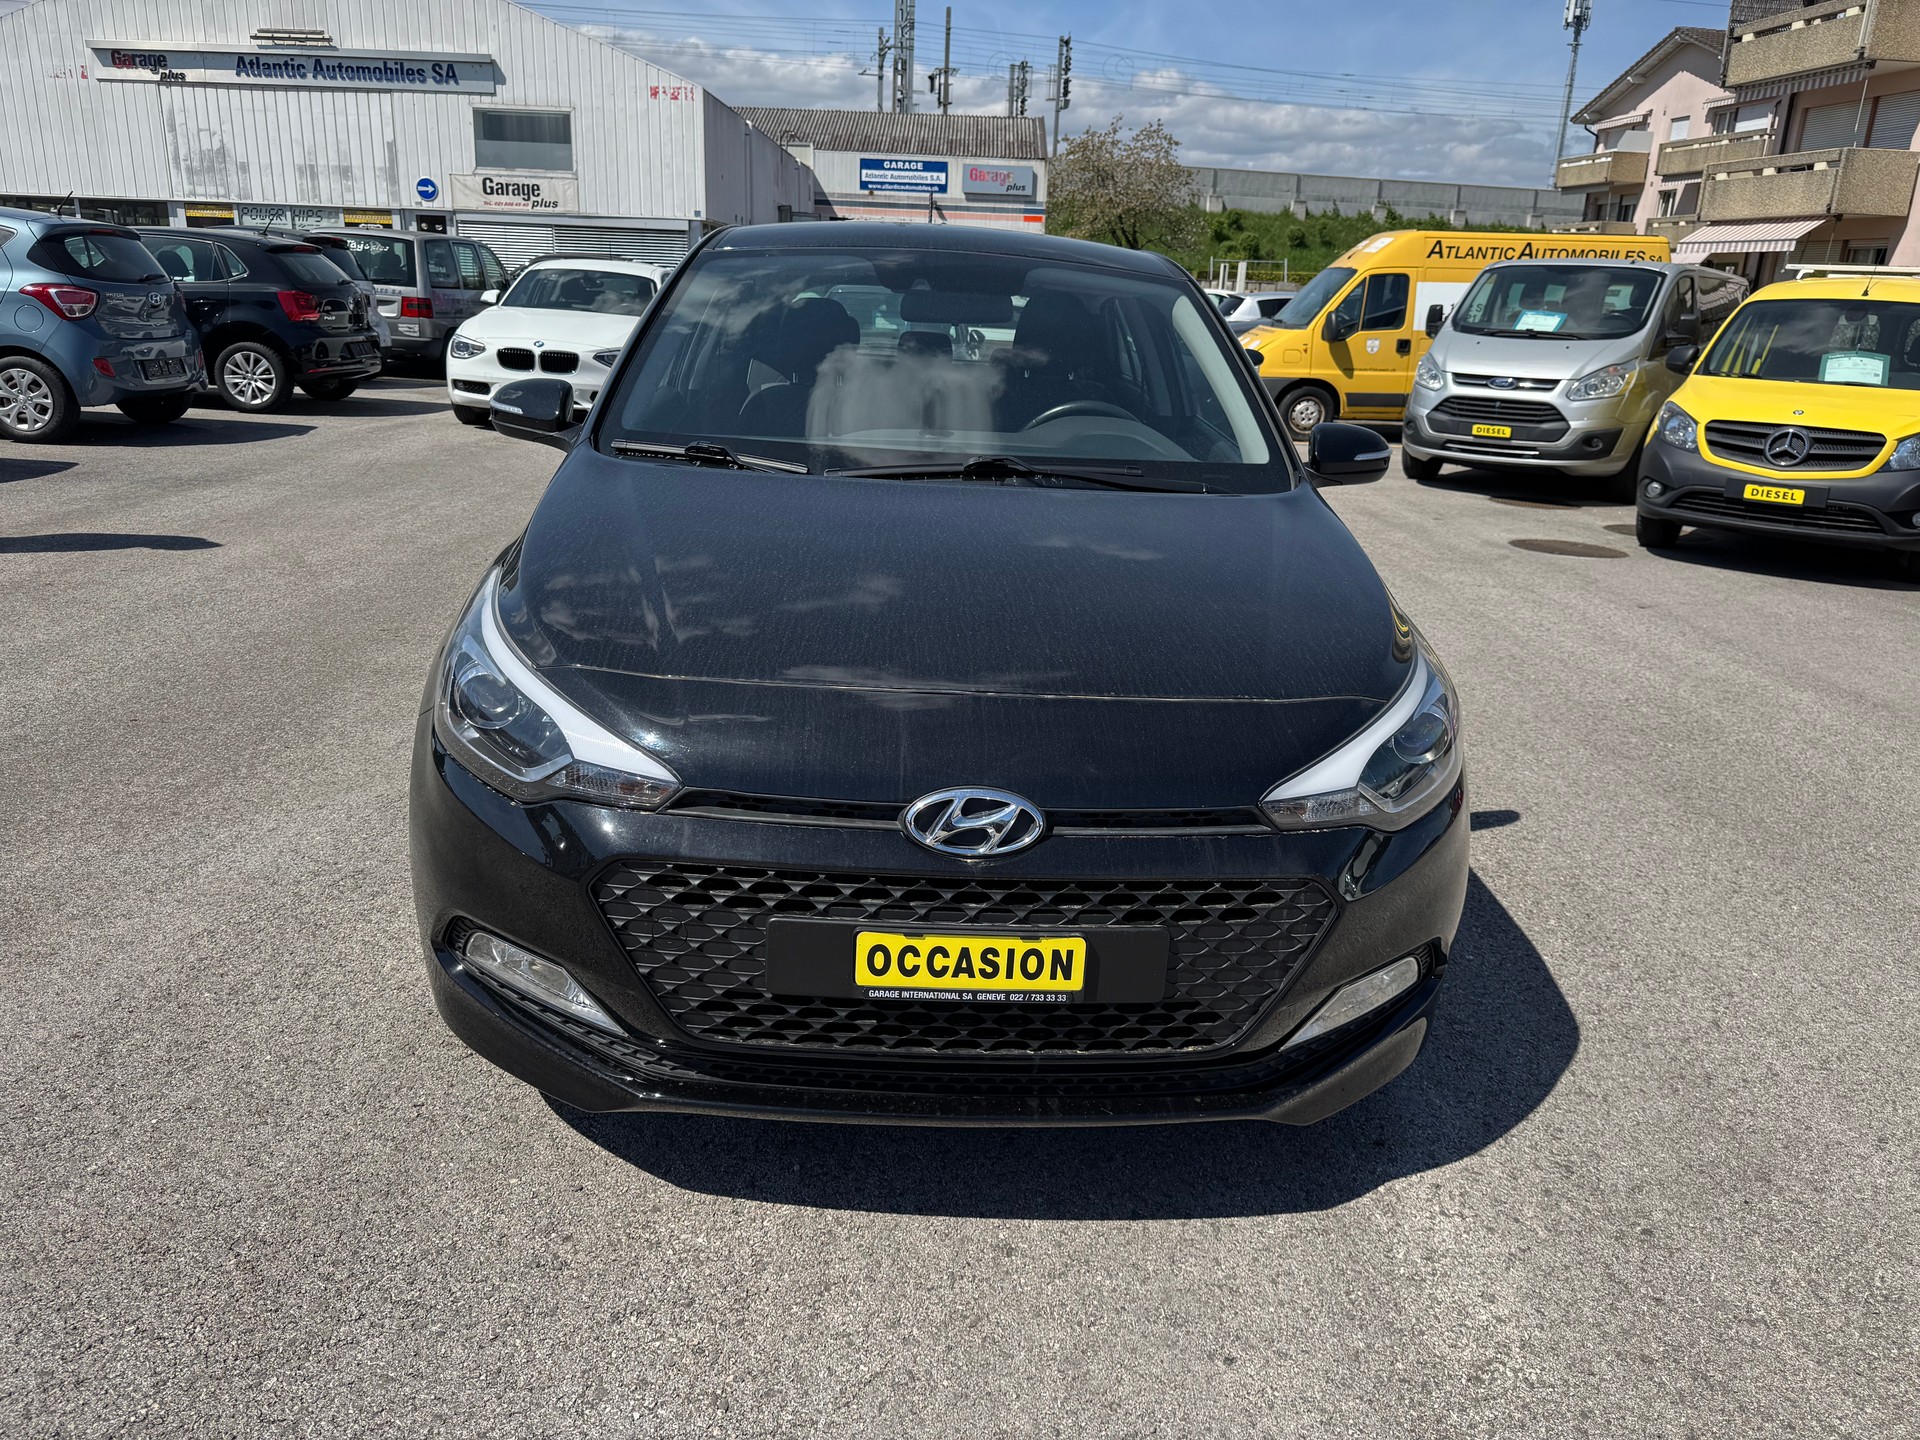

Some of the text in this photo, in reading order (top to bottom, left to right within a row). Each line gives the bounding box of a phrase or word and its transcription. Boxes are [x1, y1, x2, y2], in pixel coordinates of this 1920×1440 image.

[111, 50, 168, 74] Garage
[160, 69, 186, 82] plus
[235, 55, 459, 85] Atlantic Automobiles SA
[883, 161, 924, 170] GARAGE
[864, 172, 889, 180] Atlantic
[890, 173, 929, 182] Automobiles
[969, 167, 1014, 186] Garage
[482, 177, 540, 201] Garage
[1006, 183, 1026, 192] plus
[531, 198, 559, 209] plus
[1426, 239, 1516, 260] ATLANTIC
[1476, 426, 1507, 436] DIESEL
[1751, 488, 1797, 501] DIESEL
[866, 943, 1074, 981] OCCASION
[868, 989, 900, 999] GARAGE
[901, 990, 961, 1000] INTERNATIONAL
[962, 992, 973, 1000] SA
[977, 992, 1006, 1001] GENEVE
[1009, 993, 1024, 1001] 022
[1030, 993, 1045, 1002] 733
[1045, 994, 1056, 1002] 33
[1056, 994, 1067, 1002] 33
